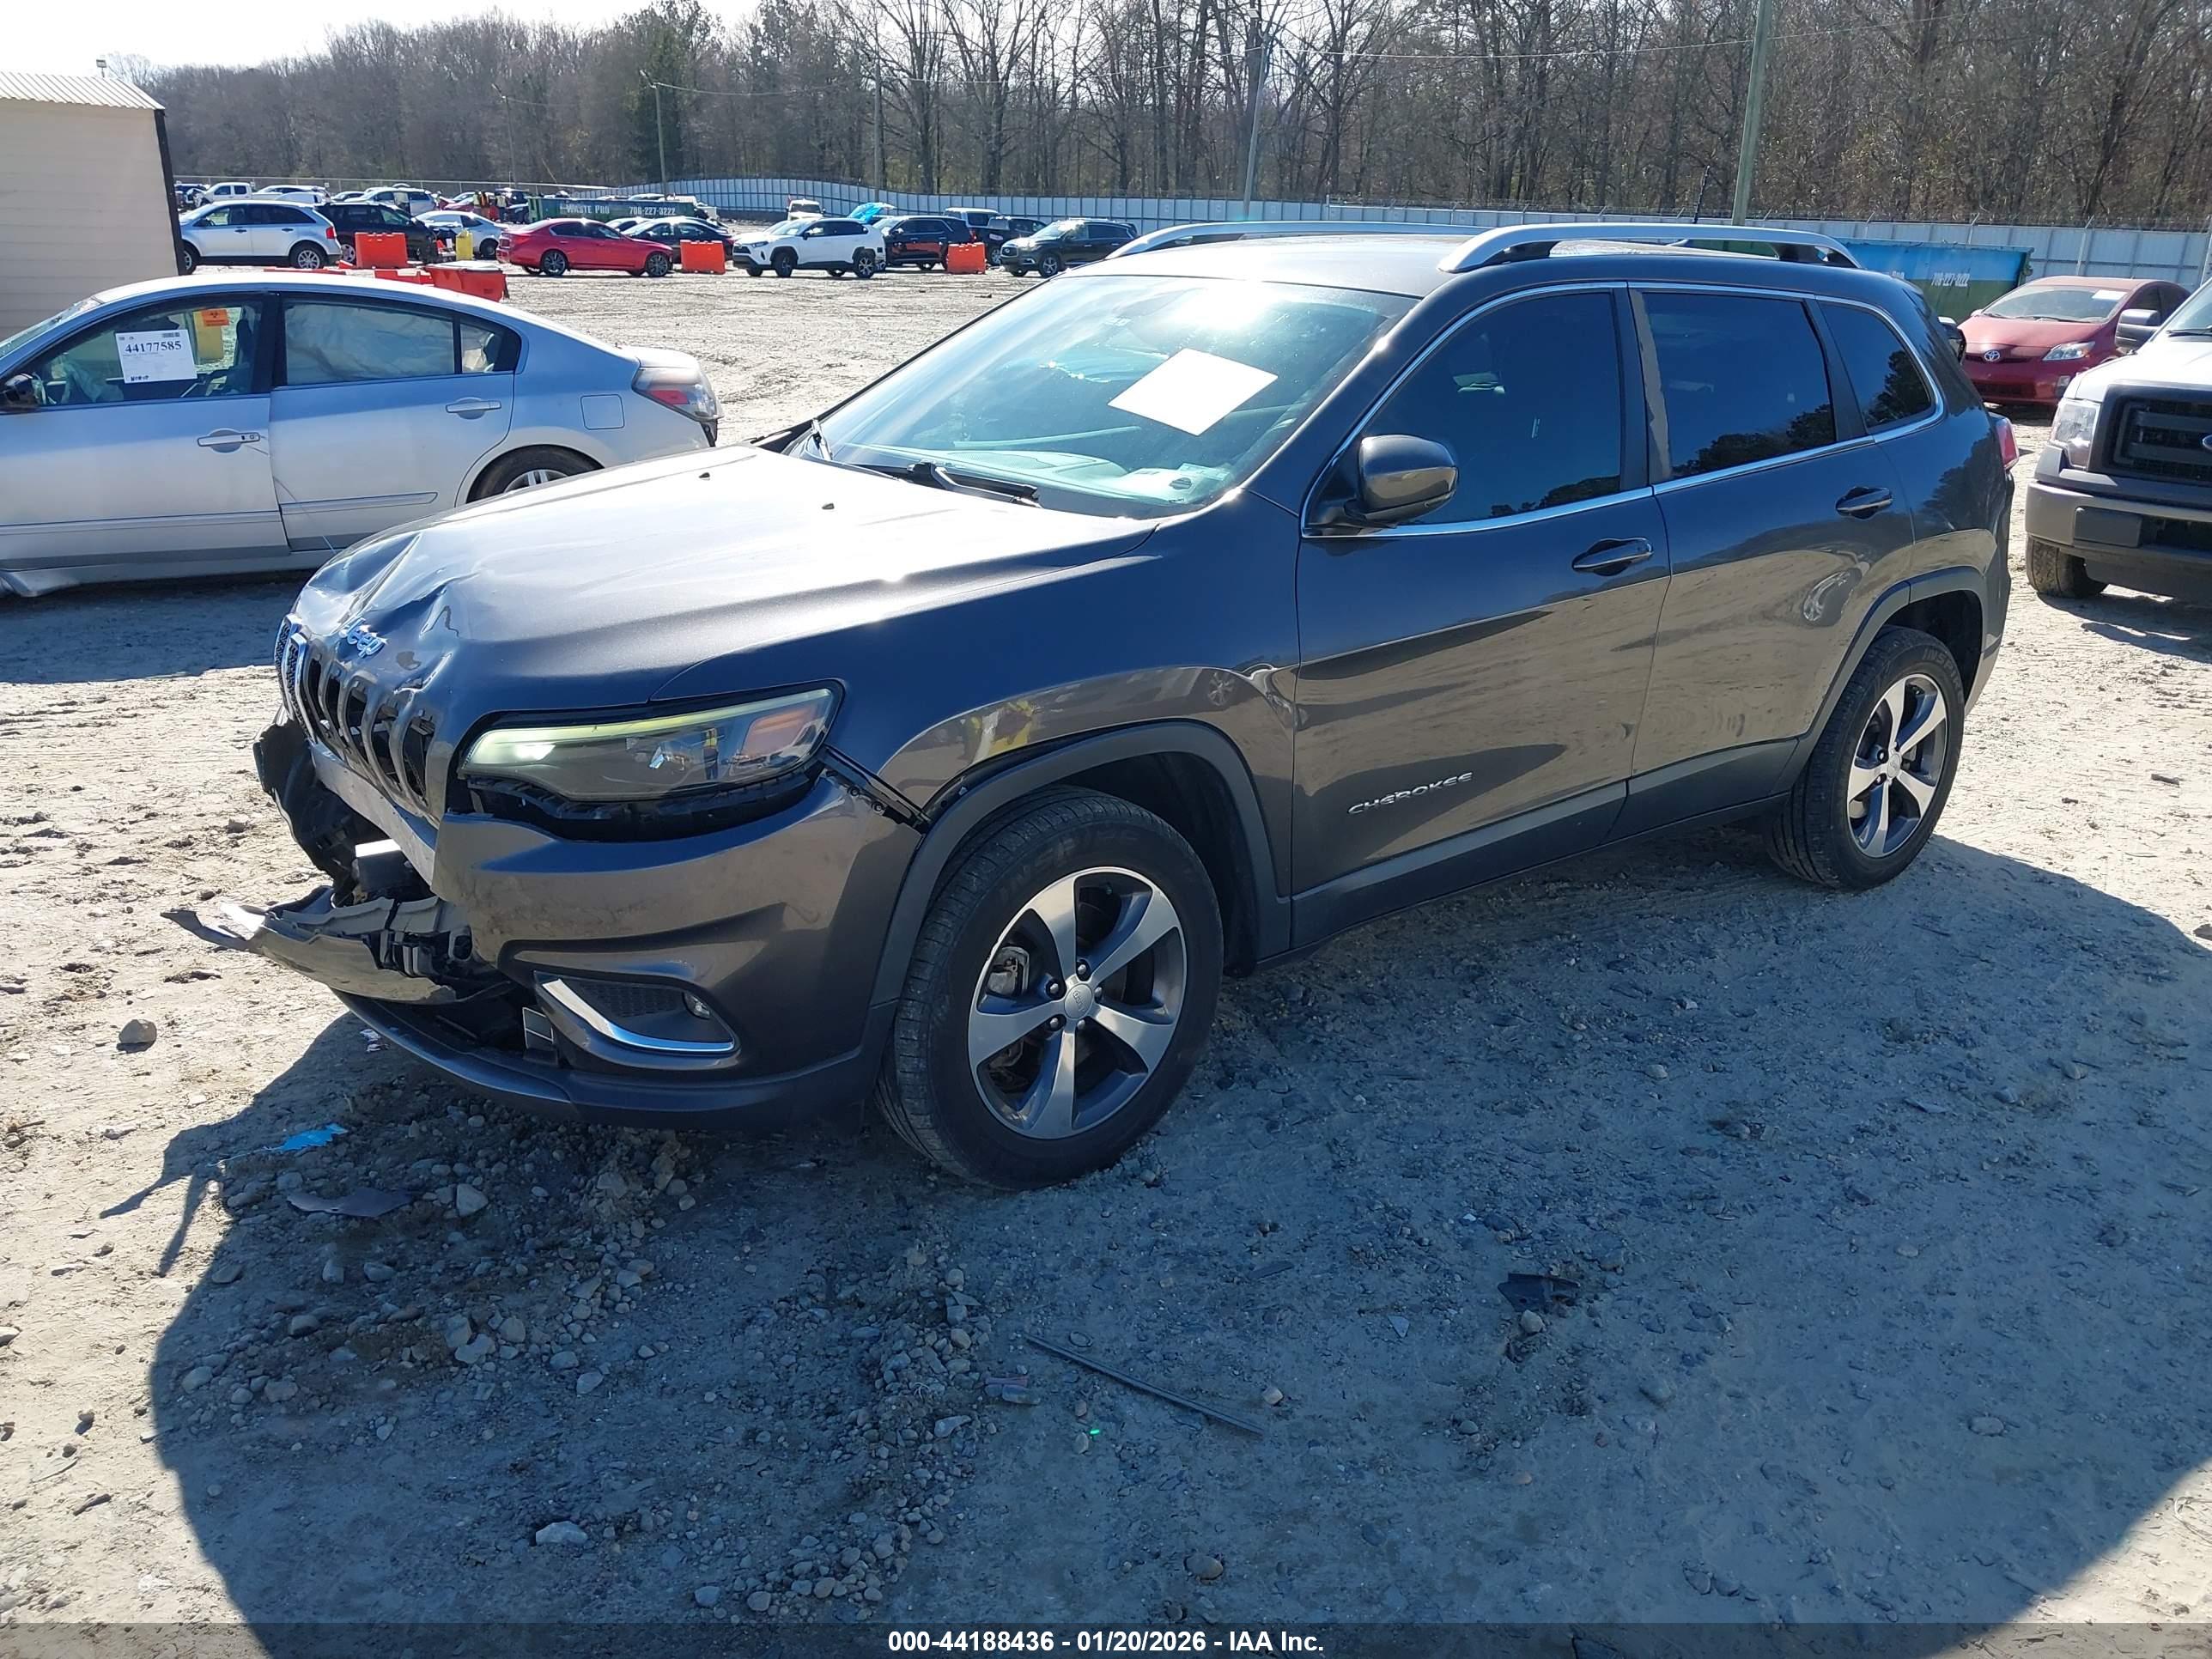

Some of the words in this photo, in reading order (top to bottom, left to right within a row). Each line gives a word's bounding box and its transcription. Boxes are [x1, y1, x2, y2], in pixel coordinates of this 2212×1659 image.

[125, 340, 182, 354] 44177585
[338, 617, 386, 658] Jeep
[1347, 771, 1474, 815] CHEROKEE
